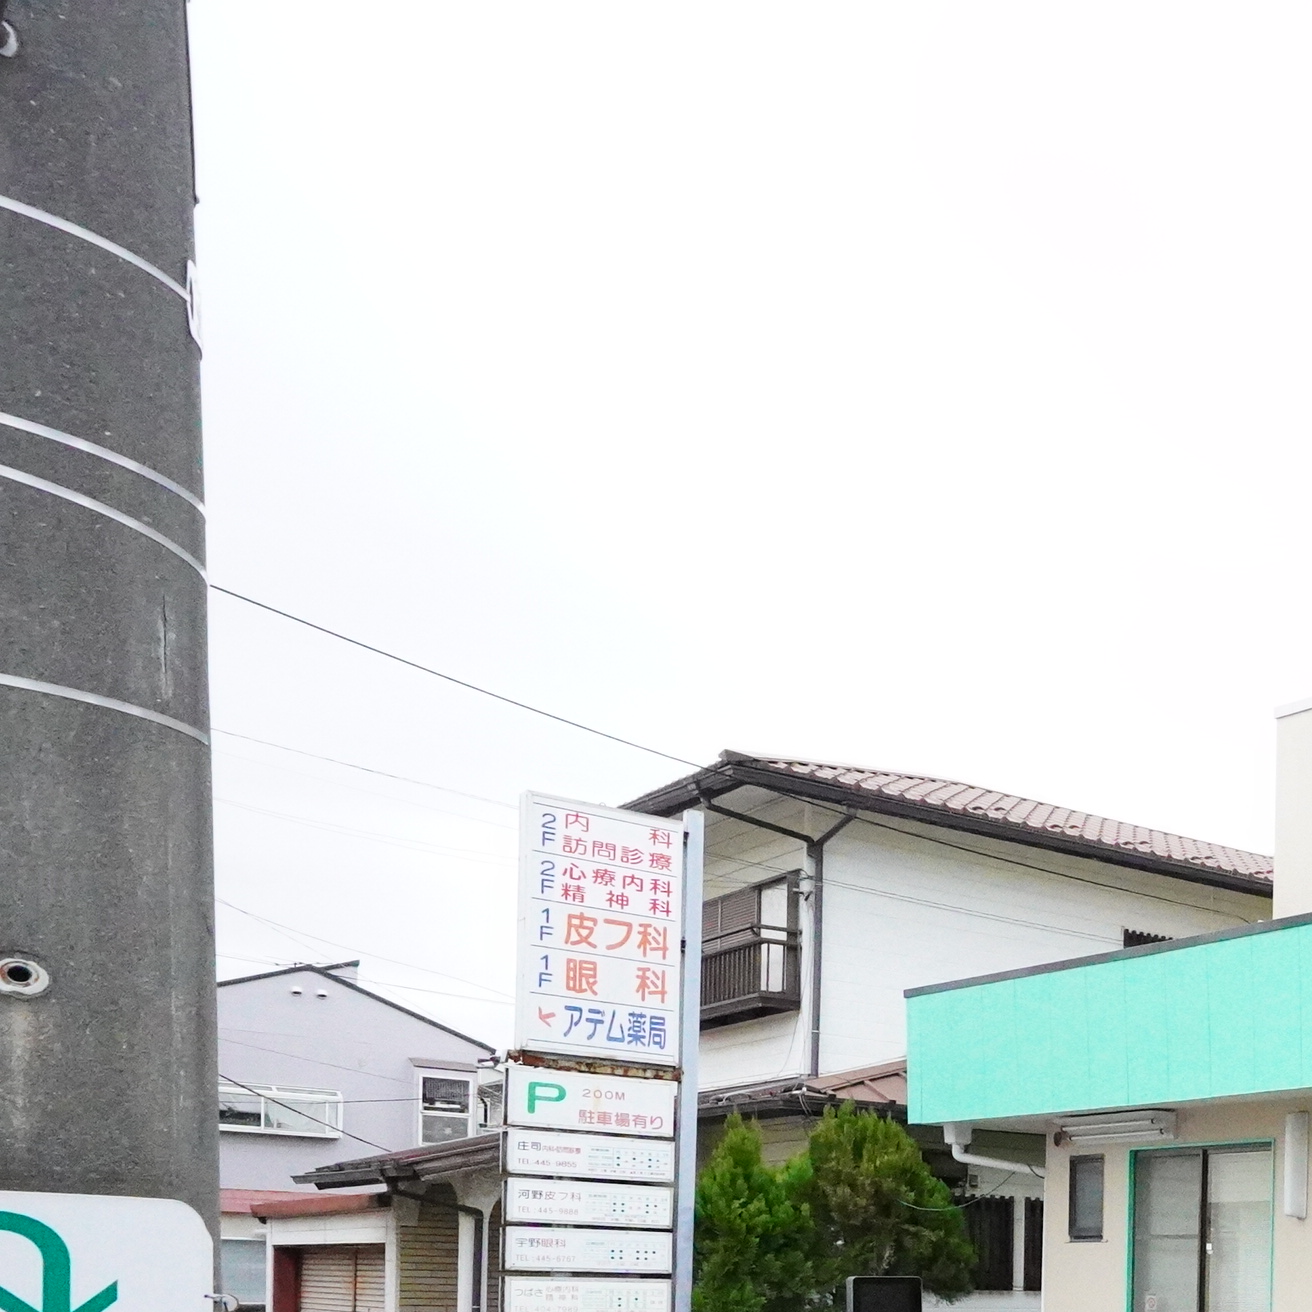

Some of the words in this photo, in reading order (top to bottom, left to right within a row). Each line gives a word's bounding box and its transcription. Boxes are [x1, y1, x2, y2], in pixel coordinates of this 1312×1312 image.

[541, 812, 556, 847] 2F
[565, 812, 673, 849] 内科
[562, 834, 673, 873] 訪問診療
[540, 860, 556, 894] 2F
[562, 862, 673, 898] 心療内科
[560, 883, 672, 917] 精神科
[539, 907, 554, 942] 1F
[564, 912, 669, 960] 皮フ科
[538, 954, 553, 988] 1F
[565, 957, 668, 1004] 眼科
[563, 1004, 667, 1050] アデム薬局
[527, 1081, 567, 1114] P
[581, 1088, 626, 1101] 200M
[577, 1109, 664, 1130] 駐車場有り
[518, 1189, 582, 1202] 河野皮フ科
[515, 1237, 566, 1249] 宇野眼科
